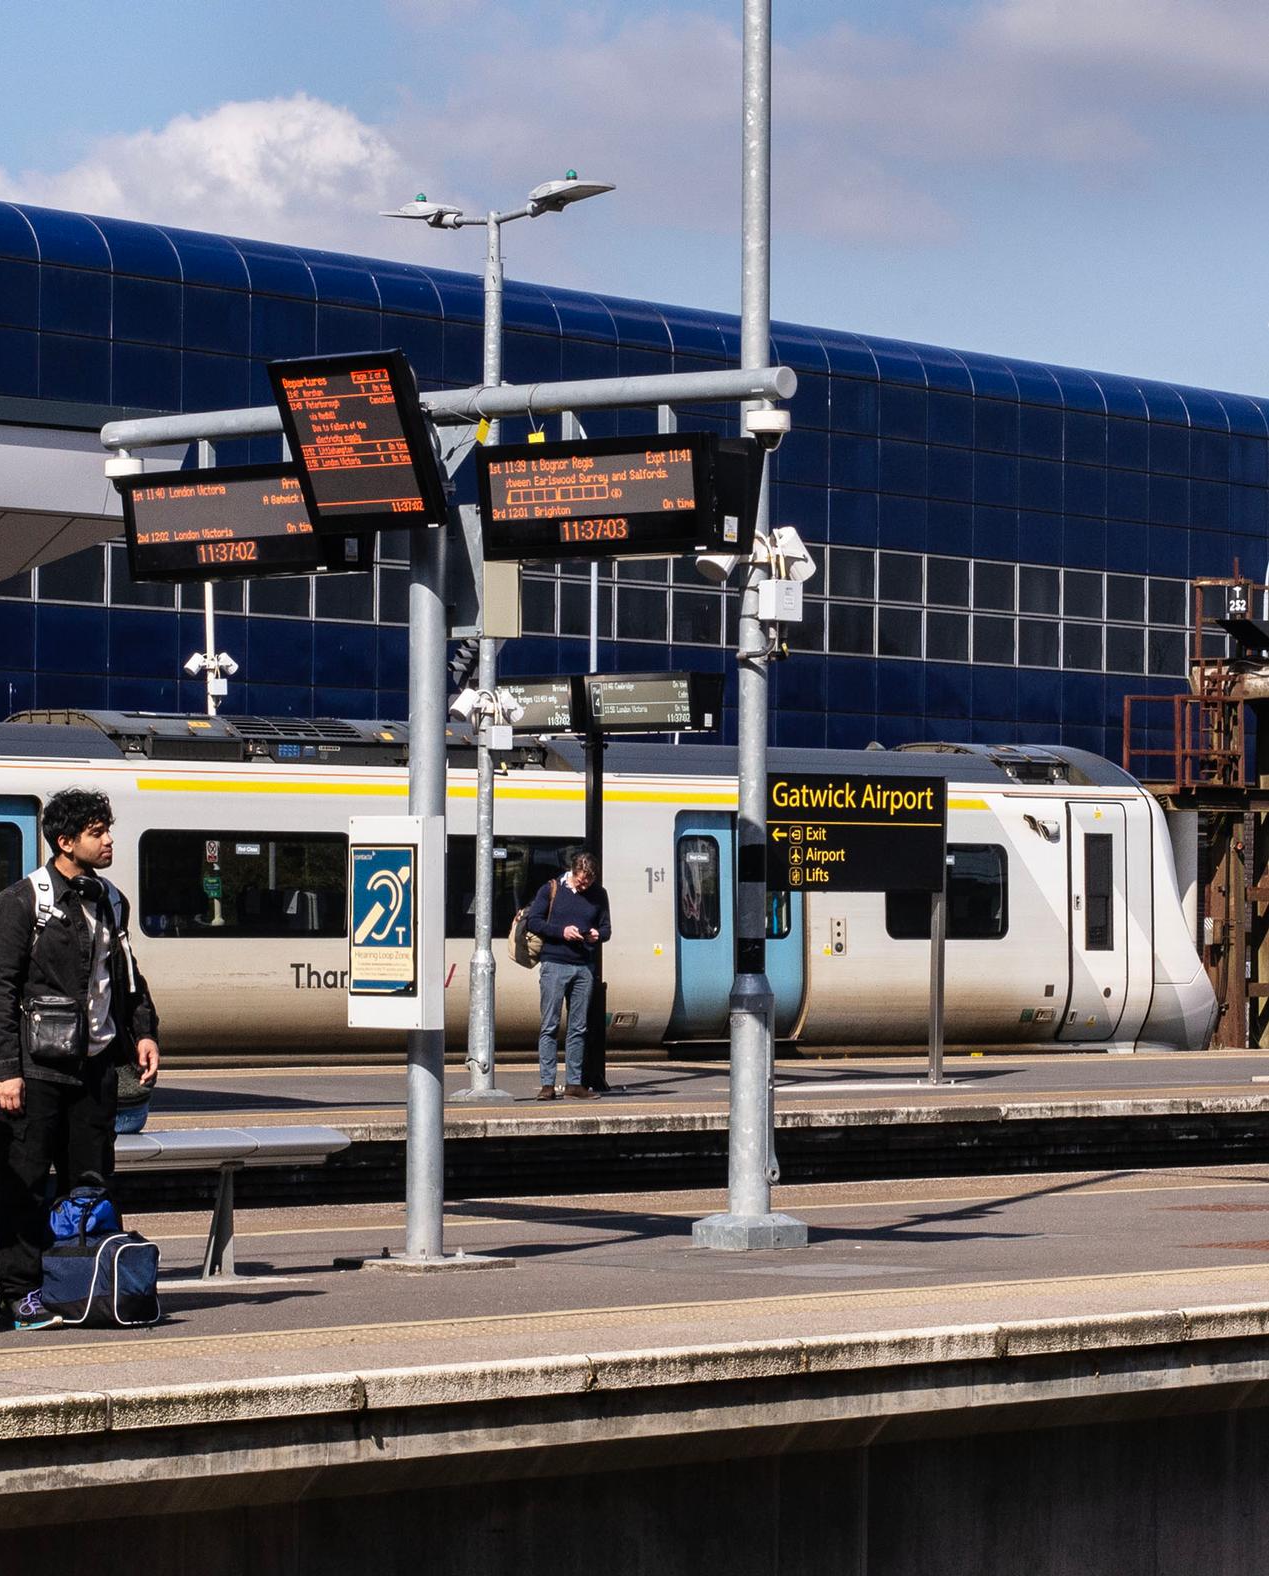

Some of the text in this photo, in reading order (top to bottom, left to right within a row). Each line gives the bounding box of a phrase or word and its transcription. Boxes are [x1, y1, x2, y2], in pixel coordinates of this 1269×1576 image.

[282, 377, 327, 389] Departures
[489, 462, 501, 474] 1st
[505, 460, 526, 473] 11:39
[540, 459, 568, 473] Bognor
[572, 456, 594, 471] Regis
[645, 449, 691, 466] Expt 11:41
[534, 474, 576, 486] Earlswood
[579, 472, 608, 485] Surrey
[612, 470, 626, 481] and
[169, 487, 195, 498] London
[197, 485, 226, 496] Victoria
[392, 501, 425, 512] 11:37:02
[662, 498, 695, 509] On time
[492, 509, 506, 519] 3rd
[534, 505, 571, 518] Brighton
[286, 522, 313, 533] On tim
[563, 519, 627, 541] 11:37:03
[137, 533, 149, 544] 2nd
[174, 530, 200, 541] London
[202, 528, 233, 539] Victoria
[200, 542, 256, 563] 11:37:02
[1229, 600, 1247, 612] 252
[667, 713, 691, 722] 11:37:02
[772, 782, 934, 816] Gatwick Airport
[806, 826, 827, 841] Exit
[805, 847, 846, 865] Airport
[644, 867, 666, 893] 1st
[806, 868, 830, 882] Lifts
[395, 927, 406, 945] T
[354, 951, 411, 961] Hearing Loop Zone
